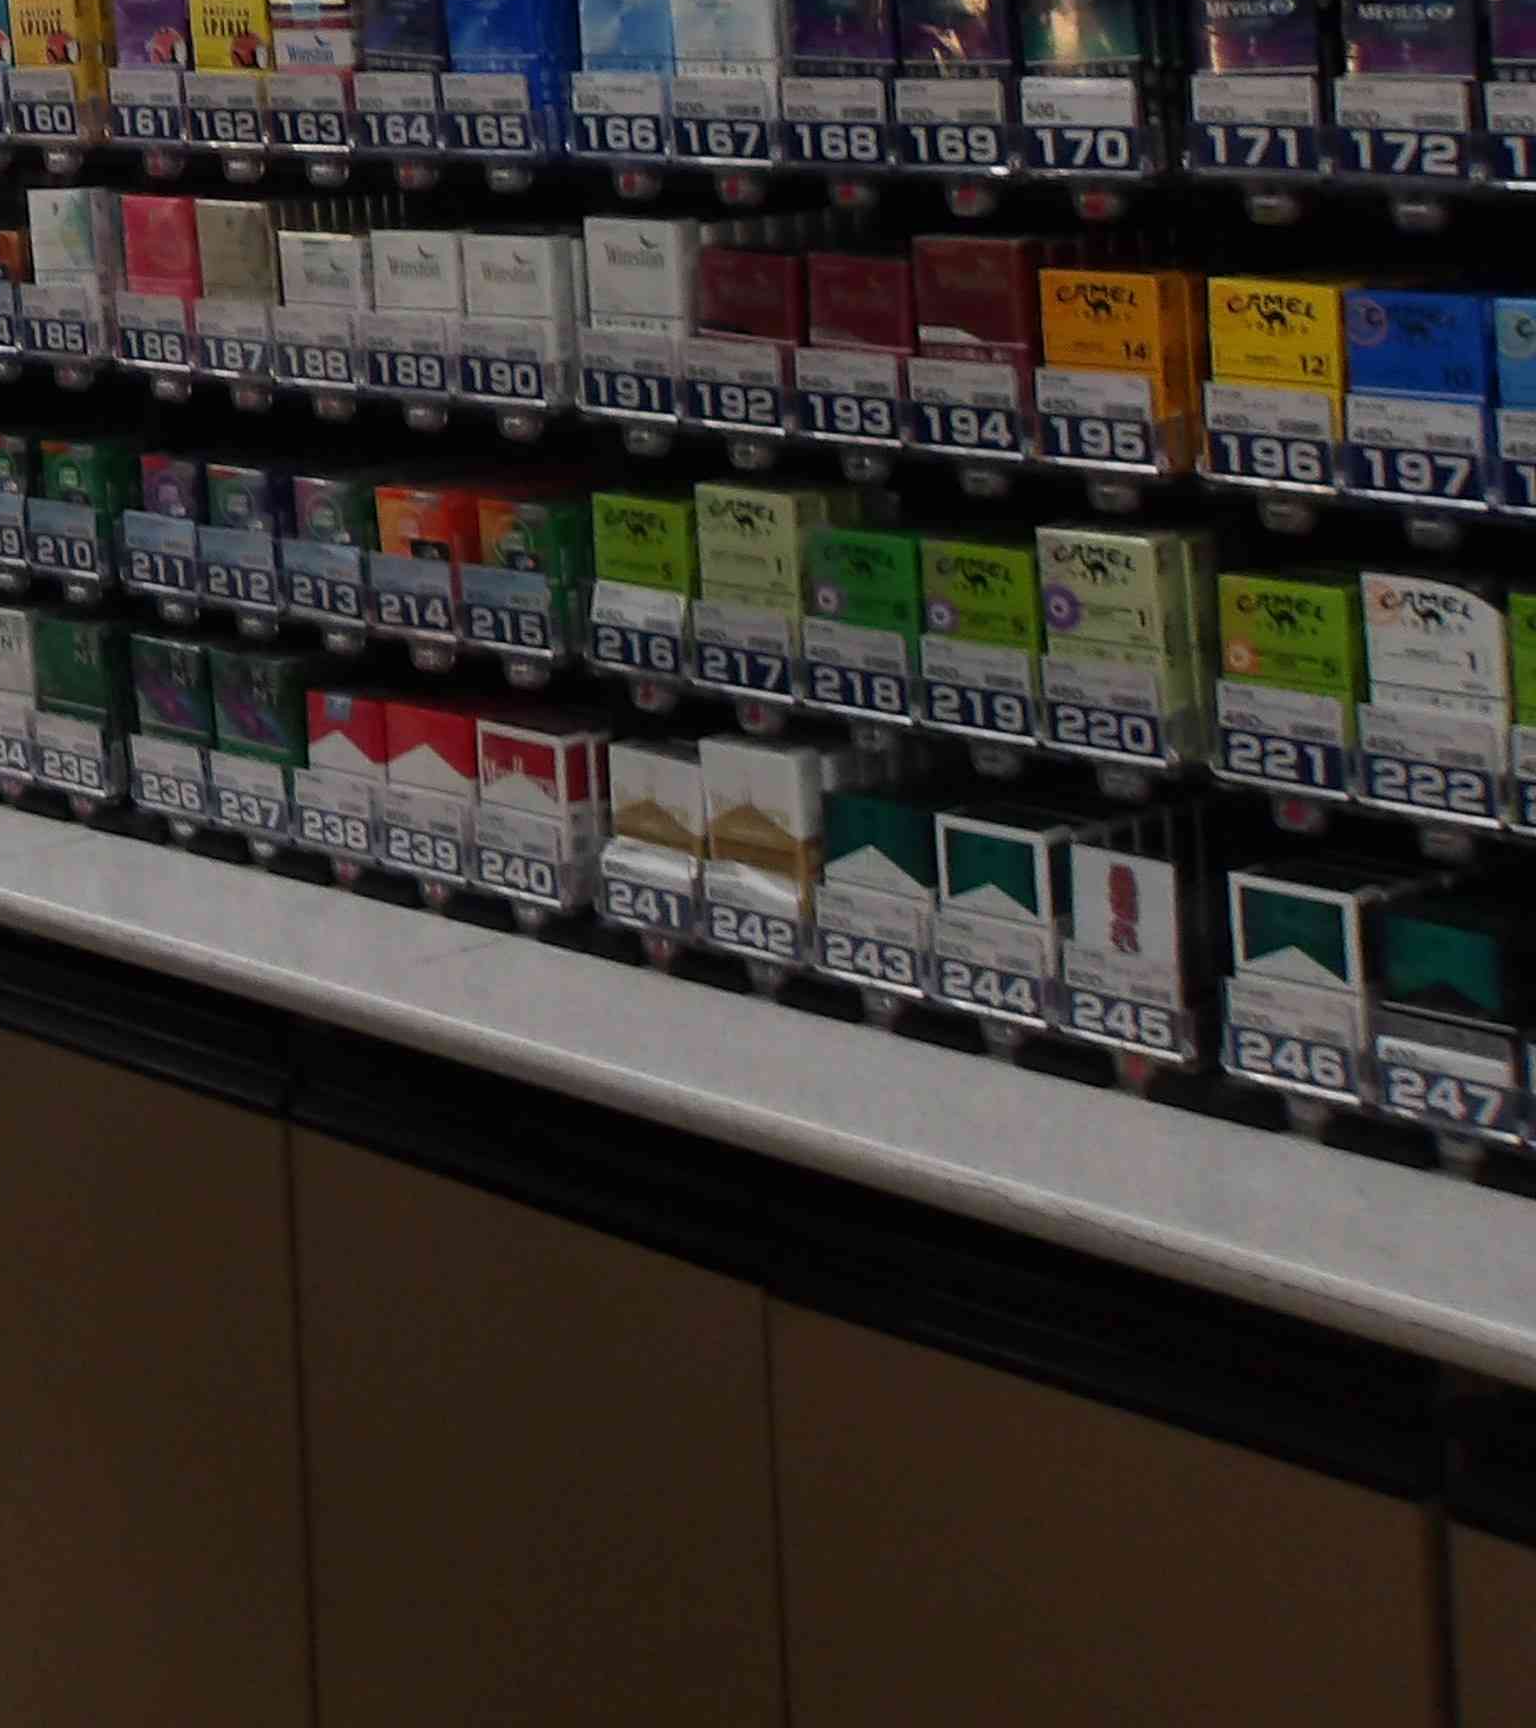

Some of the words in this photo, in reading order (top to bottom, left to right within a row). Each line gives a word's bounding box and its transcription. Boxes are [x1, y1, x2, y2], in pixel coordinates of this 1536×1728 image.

[16, 103, 70, 133] 160
[119, 106, 173, 137] 161
[196, 109, 255, 142] 162
[277, 112, 343, 143] 163
[368, 113, 430, 146] 164
[454, 114, 524, 149] 165
[583, 115, 656, 152] 166
[675, 122, 760, 157] 167
[796, 122, 878, 161] 168
[912, 124, 999, 163] 169
[1037, 129, 1128, 167] 170
[1206, 126, 1300, 167] 171
[1350, 129, 1459, 173] 172
[30, 321, 84, 352] 185
[127, 329, 183, 362] 186
[205, 336, 263, 371] 187
[376, 351, 442, 388] 189
[468, 357, 540, 394] 190
[591, 371, 669, 409] 191
[696, 382, 775, 422] 192
[808, 392, 892, 435] 193
[925, 408, 1011, 448] 194
[1051, 417, 1144, 459] 195
[1222, 436, 1322, 479] 196
[1365, 448, 1471, 493] 197
[37, 534, 93, 566] 210
[293, 578, 357, 614] 213
[380, 593, 448, 629] 214
[470, 610, 543, 646] 215
[597, 629, 676, 669] 216
[700, 648, 782, 690] 217
[813, 667, 903, 709] 218
[932, 686, 1025, 727] 219
[1056, 710, 1155, 753] 220
[1229, 732, 1327, 786] 221
[142, 775, 200, 809] 236
[220, 789, 282, 827] 237
[1372, 765, 1487, 813] 222
[302, 809, 368, 848] 238
[388, 828, 457, 870] 239
[480, 849, 553, 894] 240
[608, 886, 682, 926] 241
[712, 908, 795, 953] 242
[822, 933, 914, 985] 243
[941, 966, 1034, 1014] 244
[1071, 992, 1174, 1049] 245
[1237, 1029, 1345, 1090] 246
[1388, 1065, 1504, 1128] 247
